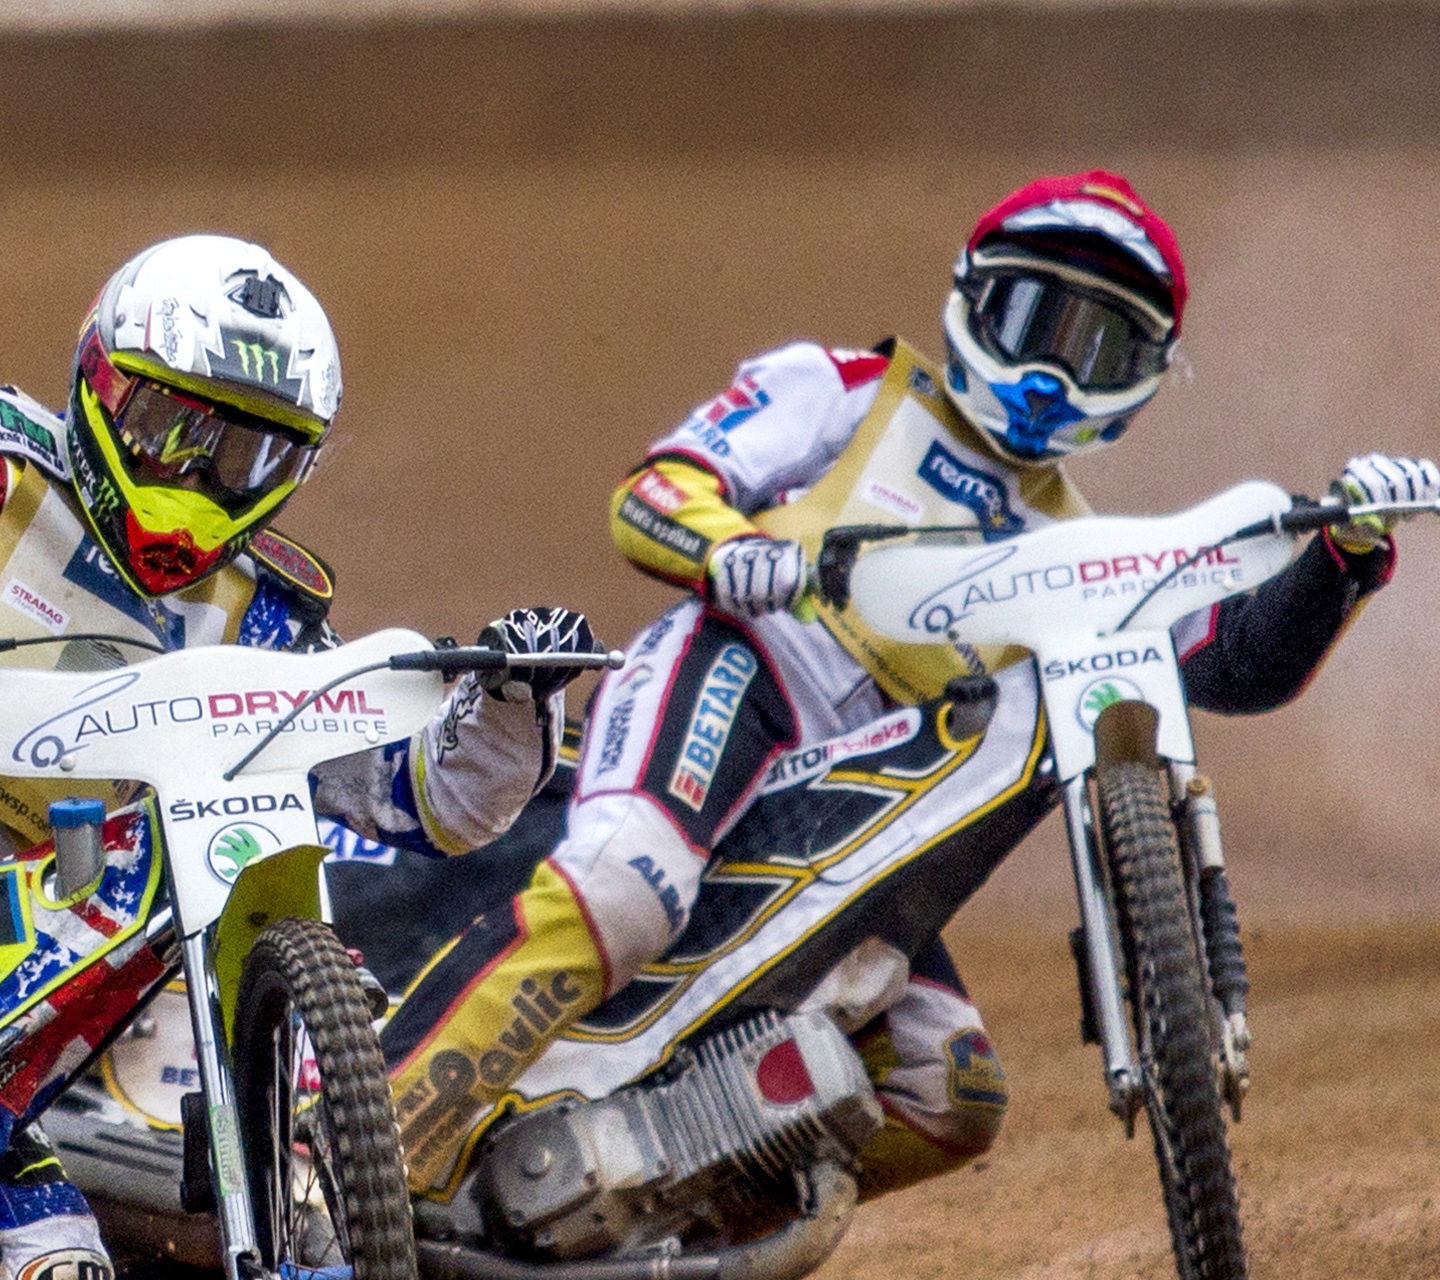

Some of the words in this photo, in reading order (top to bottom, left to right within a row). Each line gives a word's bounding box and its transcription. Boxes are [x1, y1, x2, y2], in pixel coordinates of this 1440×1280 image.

[10, 585, 64, 625] STRABAG
[1045, 646, 1164, 682] ŠKODA
[685, 643, 754, 772] BETARD
[212, 718, 390, 739] PARDUBICE
[170, 793, 306, 822] ŠKODA
